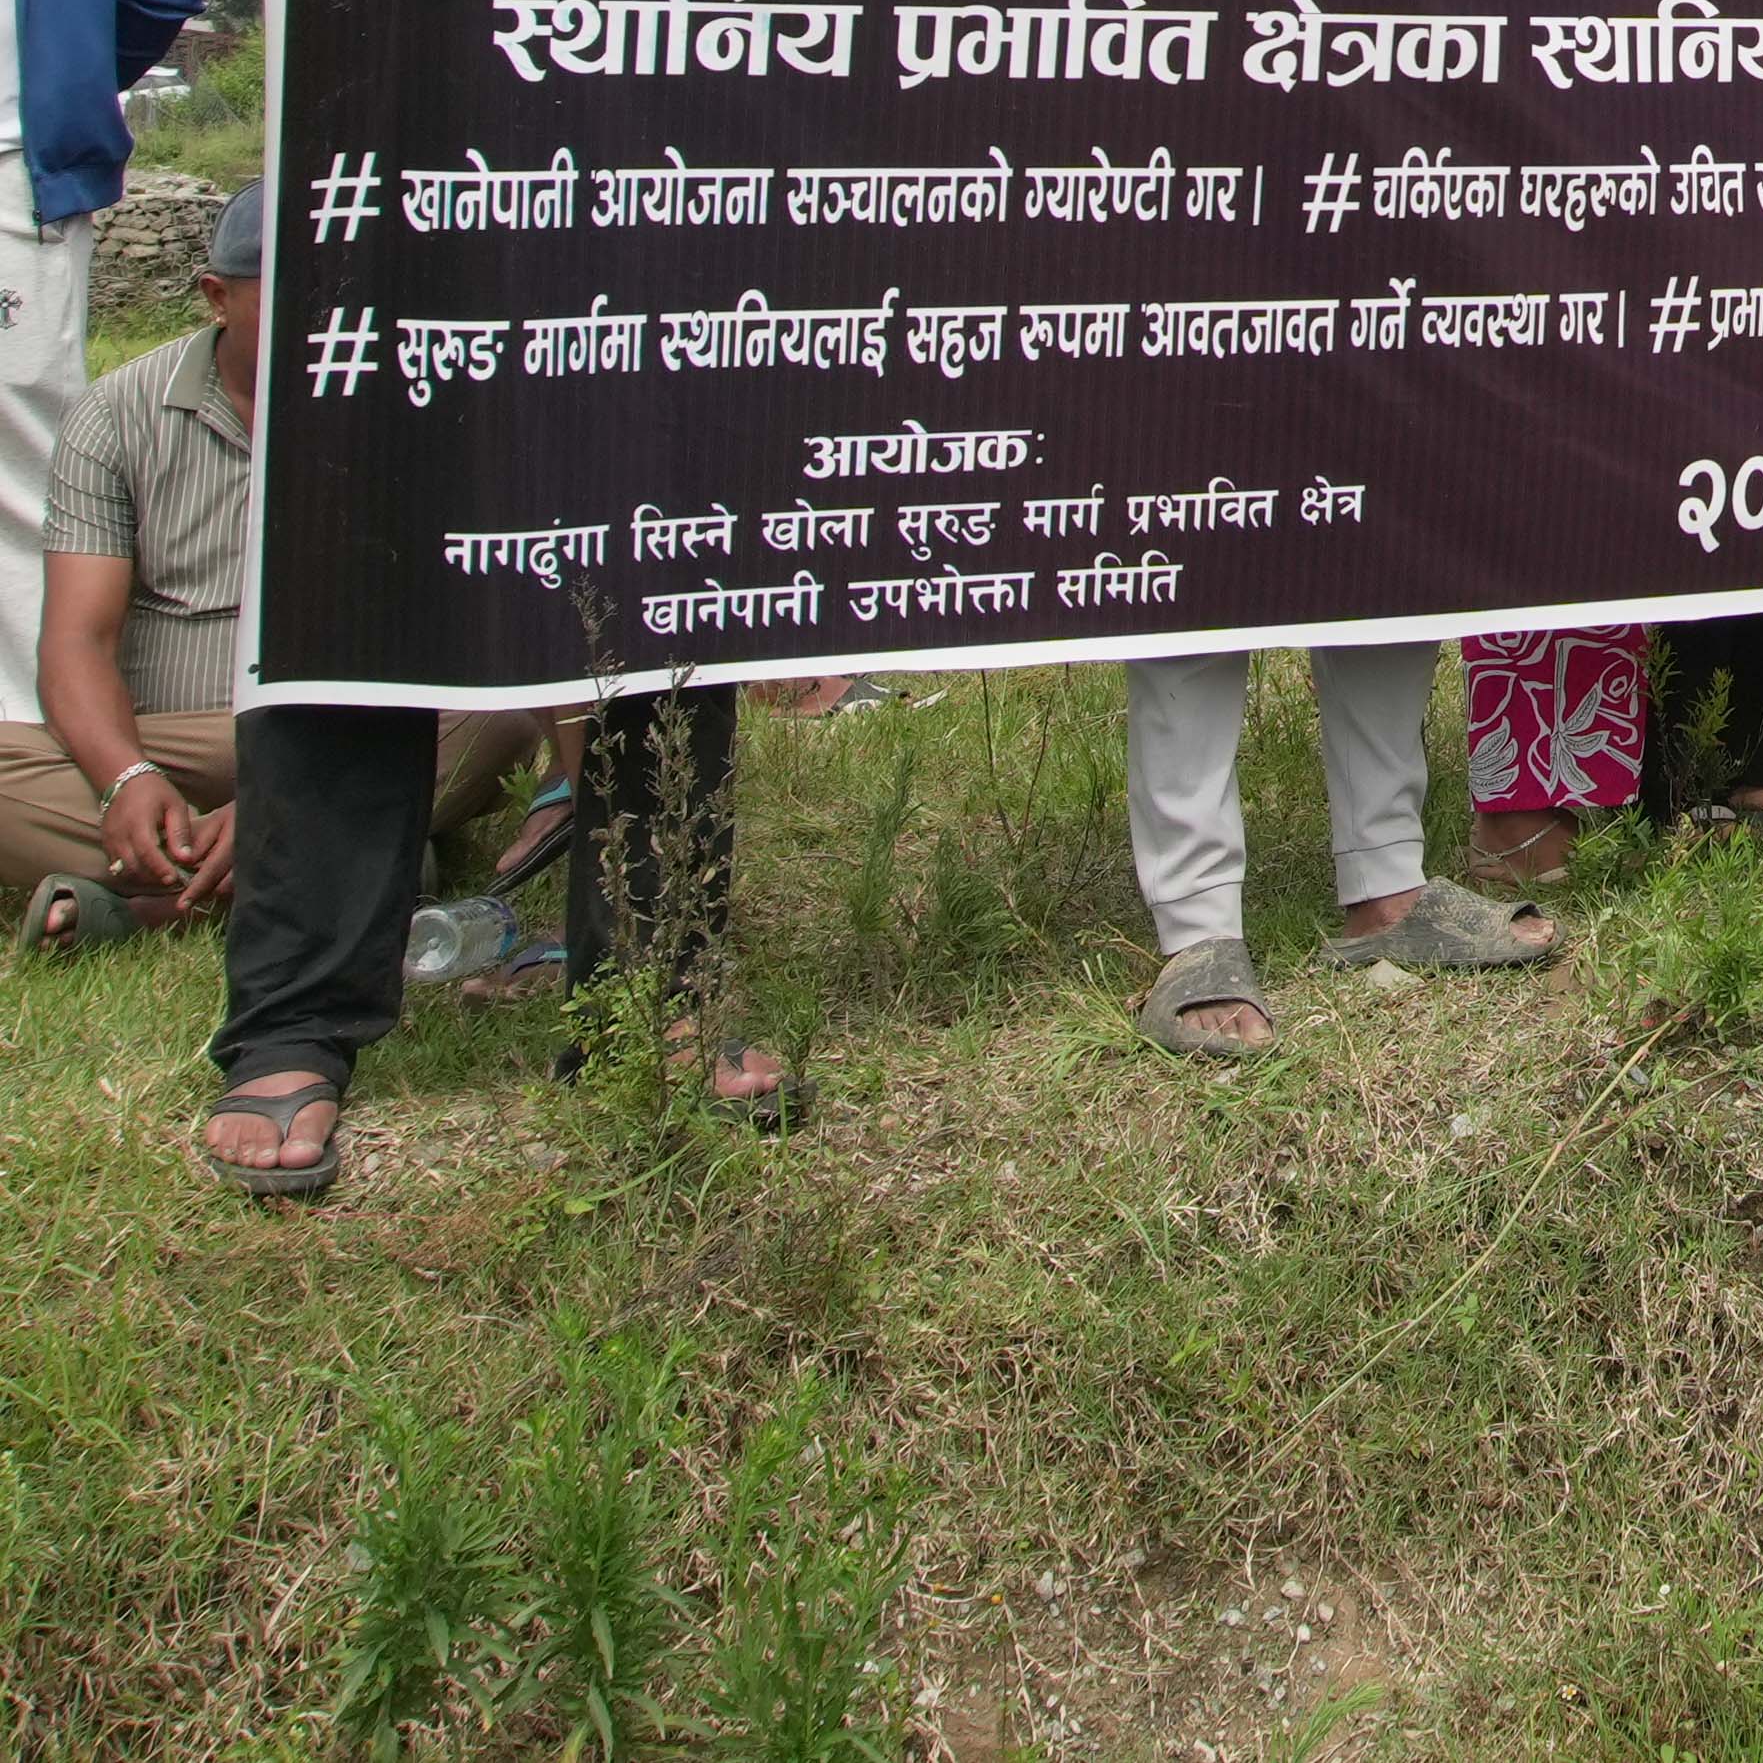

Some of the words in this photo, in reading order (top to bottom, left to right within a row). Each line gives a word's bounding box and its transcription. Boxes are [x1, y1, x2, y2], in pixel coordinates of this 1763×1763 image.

[402, 148, 578, 231] खानेपानी
[591, 147, 774, 226] आयोजना
[787, 146, 1013, 226] सञ्चालनको
[1026, 147, 1175, 222] ग्यारेण्टी
[1521, 145, 1660, 231] घरहरूको
[1670, 145, 1746, 216] उचित
[397, 319, 509, 406] सुरूङ
[524, 295, 647, 376] मार्गमा
[660, 288, 899, 377] स्थानियलाई
[907, 306, 1007, 378] सहज
[1020, 304, 1130, 360] रूपमा
[1142, 300, 1339, 358] आवतजावत
[1351, 278, 1415, 350] गर्ने
[1422, 294, 1550, 347] व्यवस्था
[445, 519, 609, 589] नागढुंगा
[631, 503, 737, 561] सिस्ने
[762, 499, 874, 550] खोला
[898, 503, 1000, 560] सुरुङ
[1024, 484, 1104, 537] मार्ग
[1127, 477, 1278, 535] प्रभावित
[1301, 476, 1365, 525] क्षेत्र
[642, 570, 824, 633] खानेपानी
[848, 564, 1034, 620] उपभोक्ता
[1057, 550, 1183, 607] समिति
